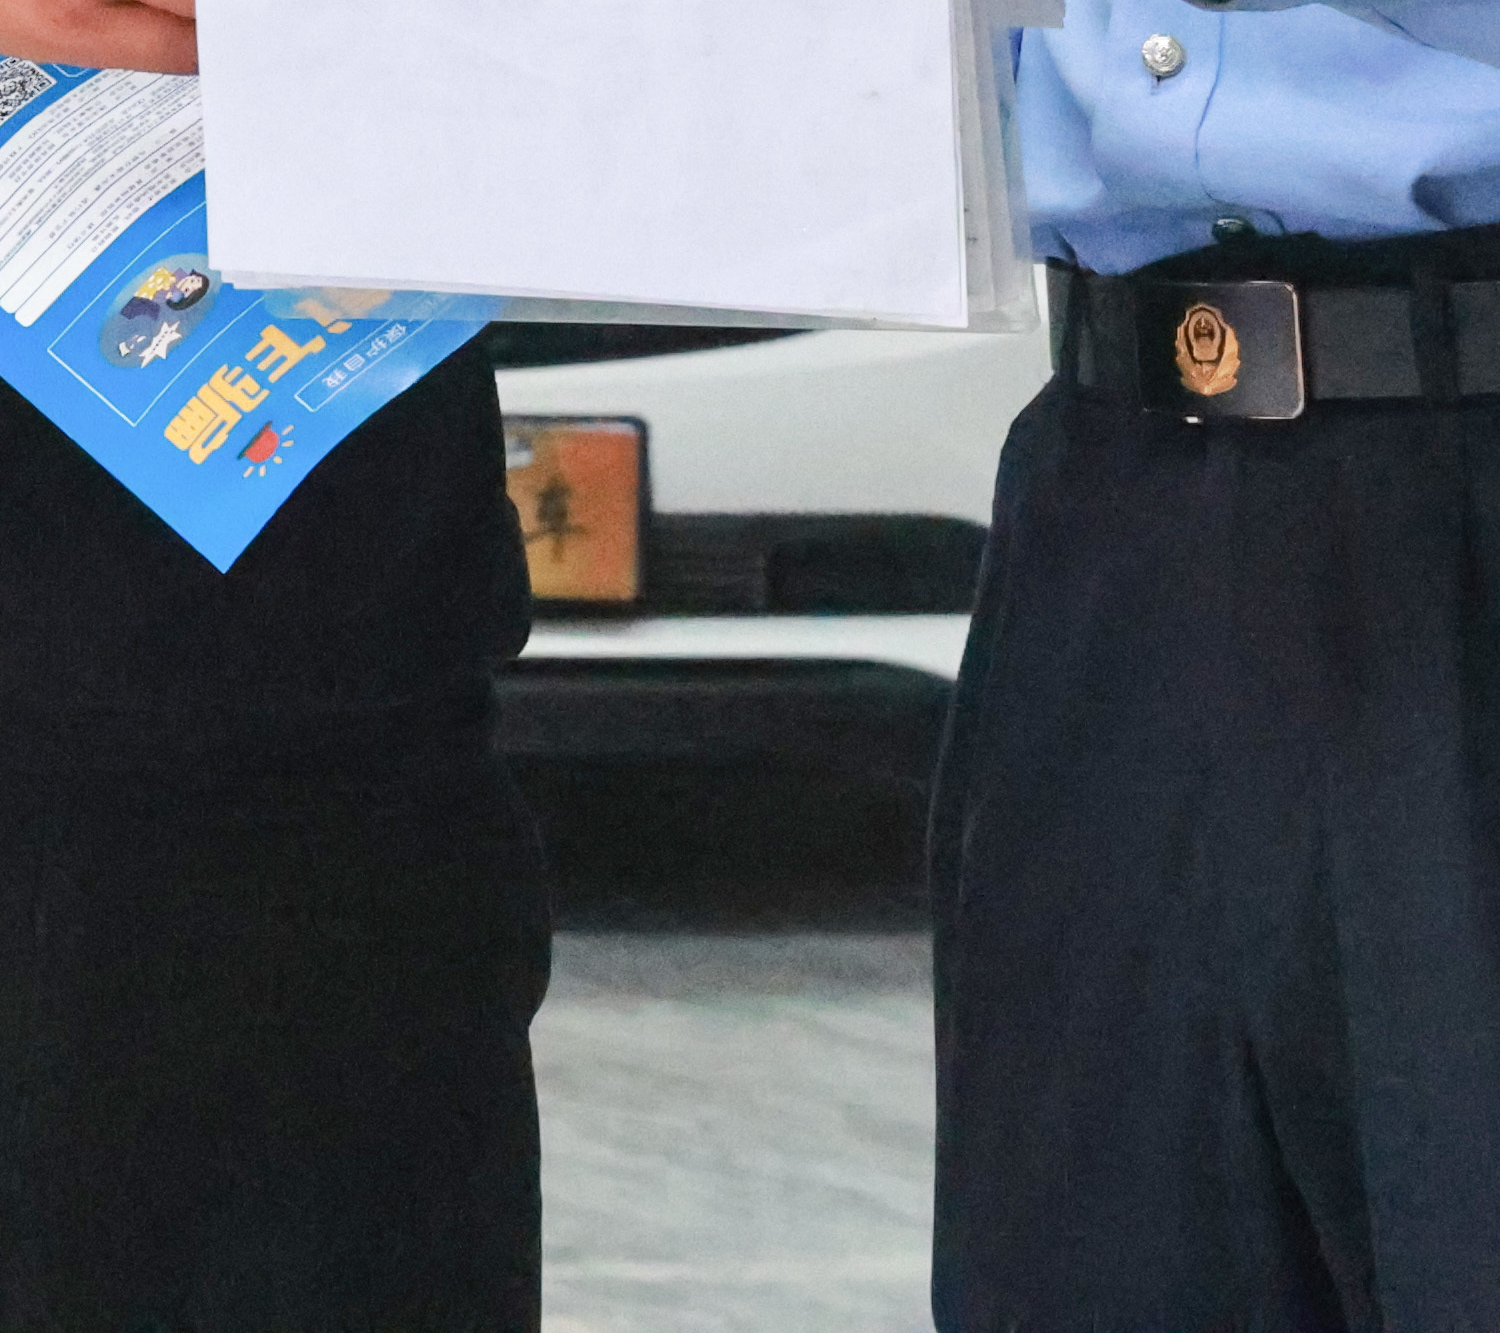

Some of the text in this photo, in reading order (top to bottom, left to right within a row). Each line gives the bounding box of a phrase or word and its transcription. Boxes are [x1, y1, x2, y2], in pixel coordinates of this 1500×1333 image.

[163, 296, 353, 465] 诈骗
[323, 322, 408, 389] 保护自我
